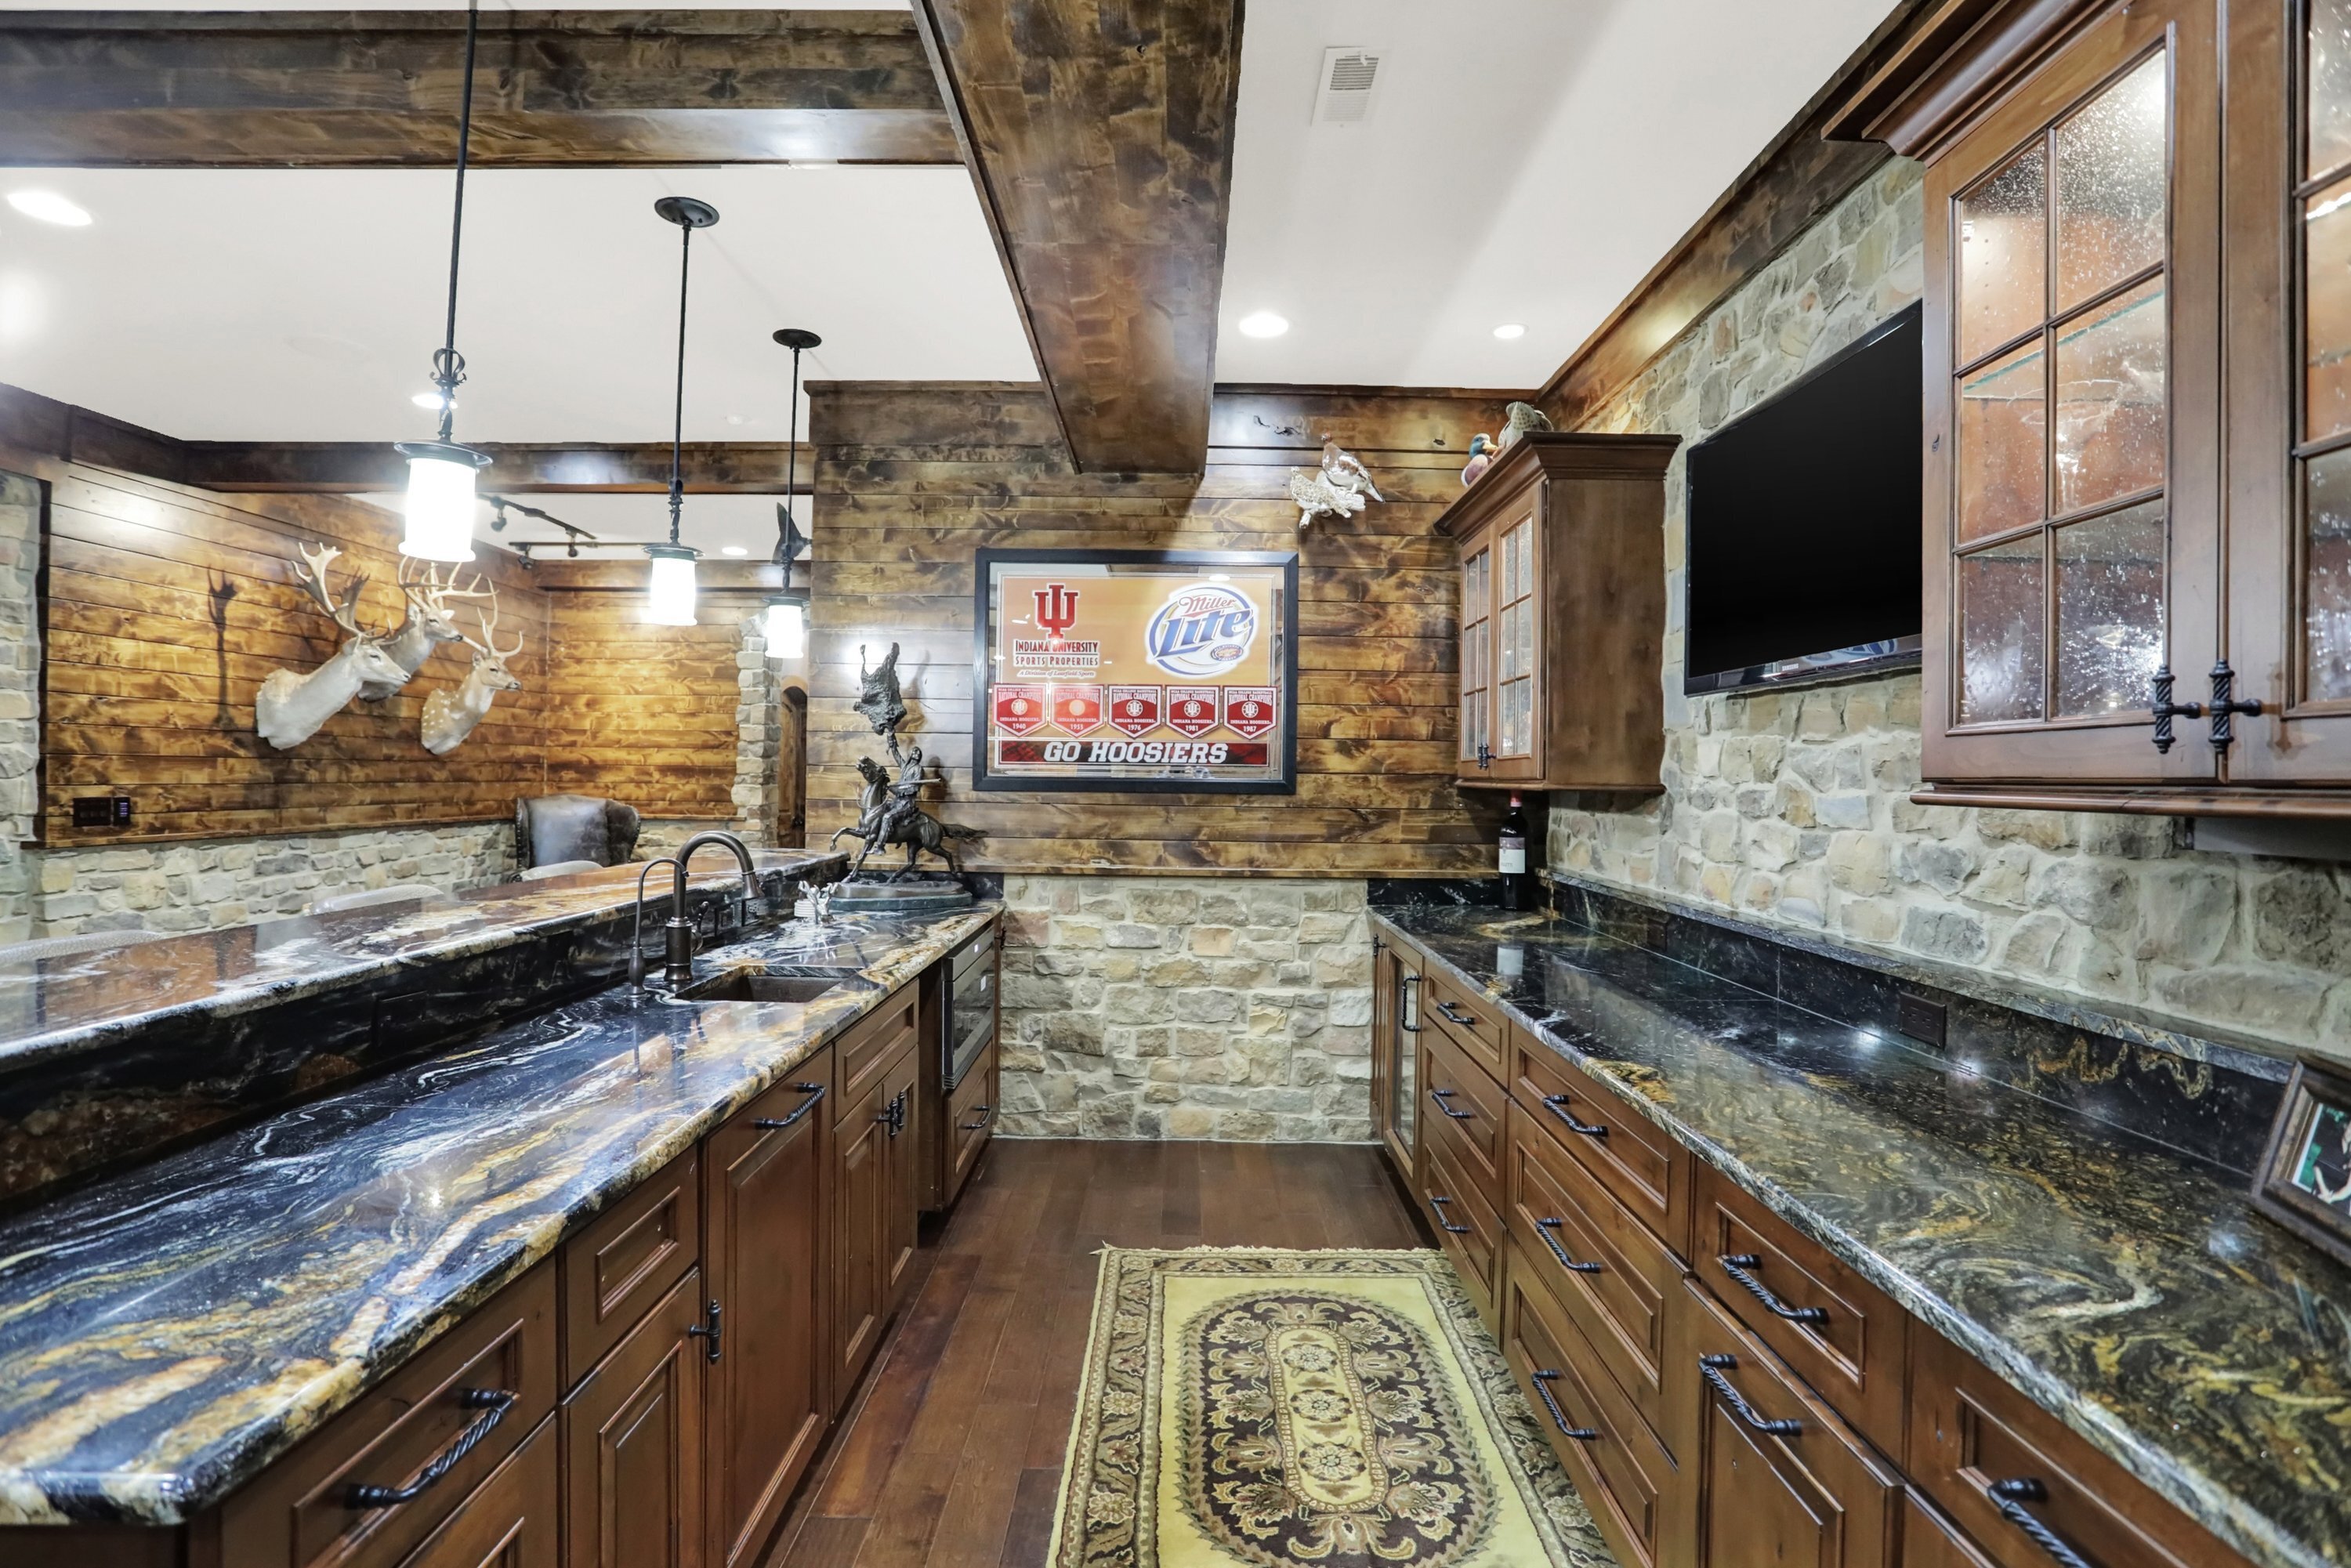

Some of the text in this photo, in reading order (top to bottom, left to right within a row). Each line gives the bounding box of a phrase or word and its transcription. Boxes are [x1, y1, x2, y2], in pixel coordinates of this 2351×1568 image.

[1179, 596, 1236, 614] Miller
[1154, 609, 1254, 658] Lite
[1016, 640, 1099, 653] INDIANA UNIVERSITY
[1016, 656, 1099, 665] SPORTS PROPERTIES
[1043, 741, 1228, 764] GO HOOSIERS
